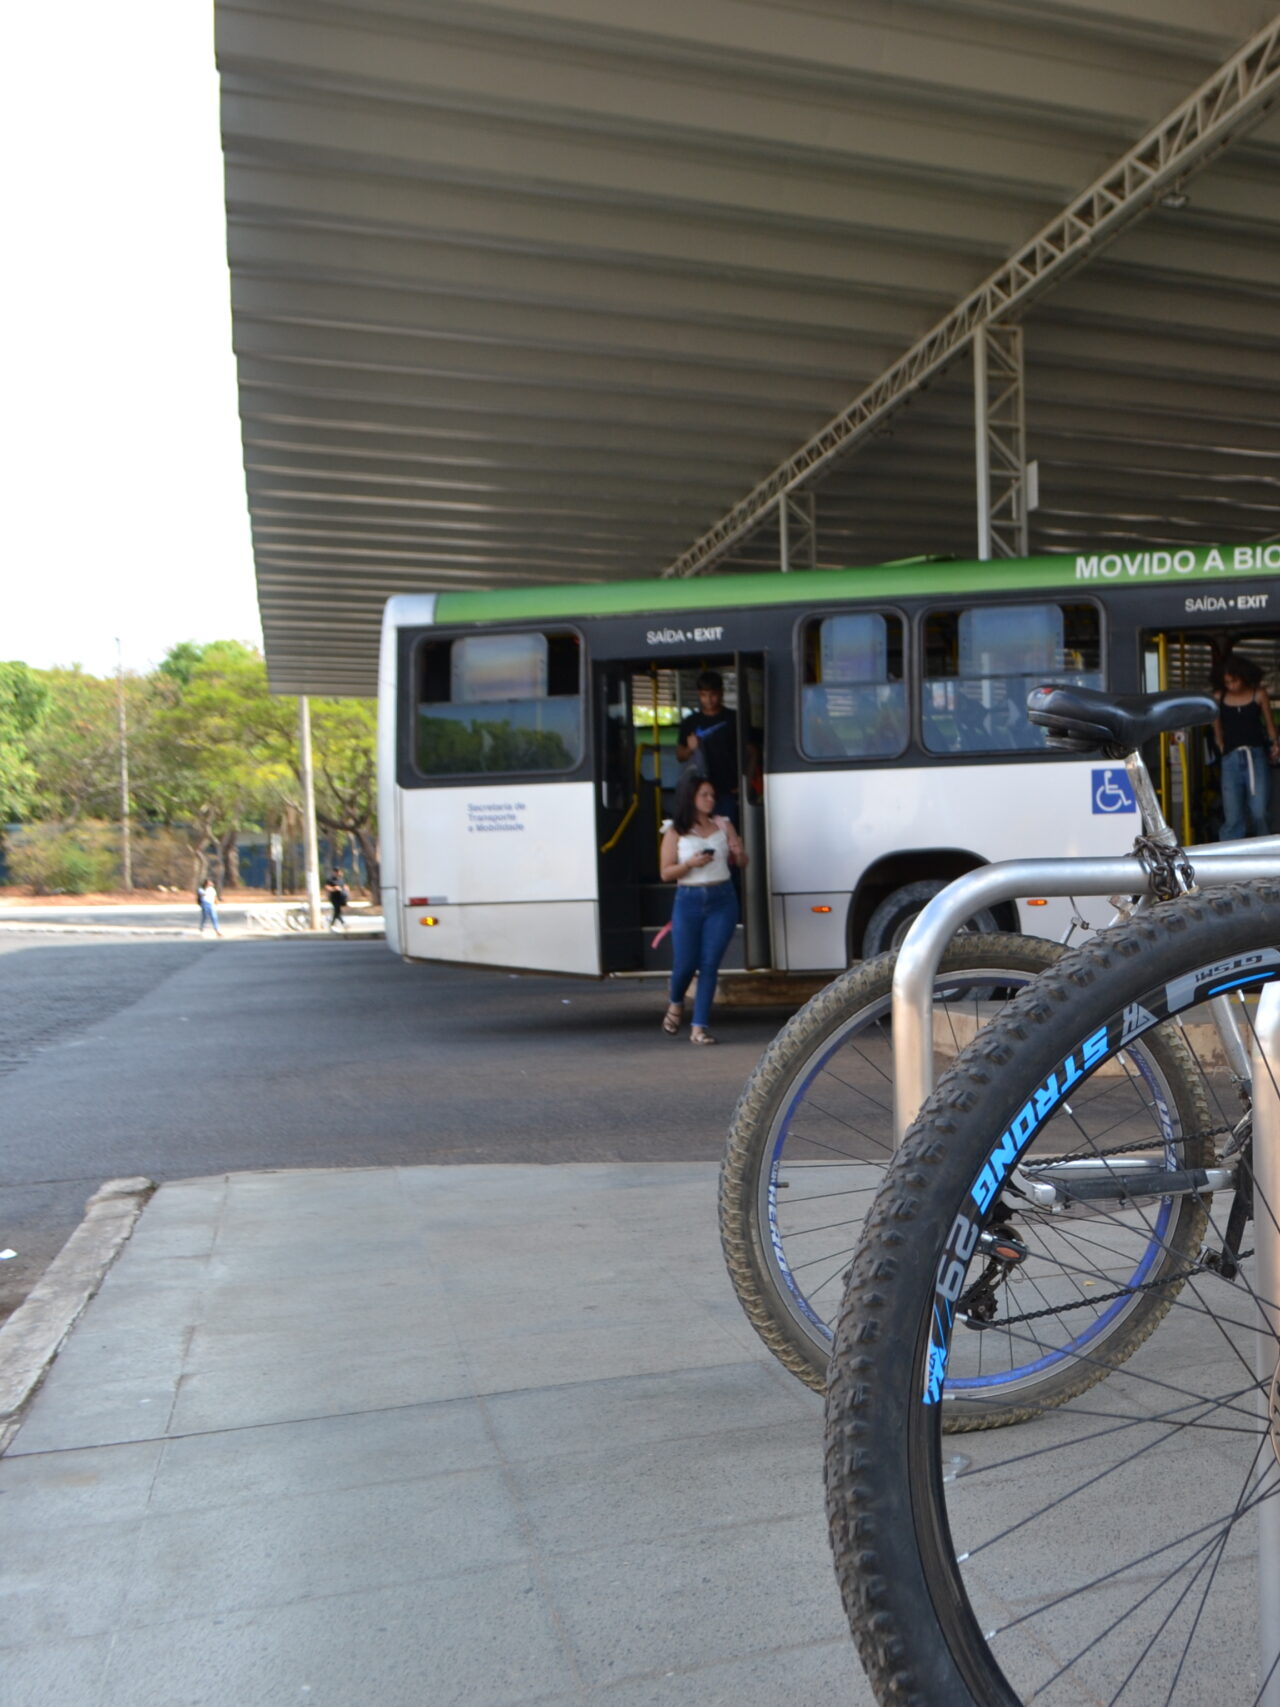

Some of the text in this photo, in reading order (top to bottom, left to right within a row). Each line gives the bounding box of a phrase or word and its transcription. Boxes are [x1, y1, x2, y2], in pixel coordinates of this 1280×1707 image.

[1076, 550, 1196, 579] MOVIDO
[1203, 549, 1224, 572] A
[1185, 595, 1268, 612] SAÍDA EXIT
[646, 626, 723, 645] SAÍDA EXIT
[970, 1025, 1109, 1216] STRONG
[936, 1215, 979, 1301] 29
